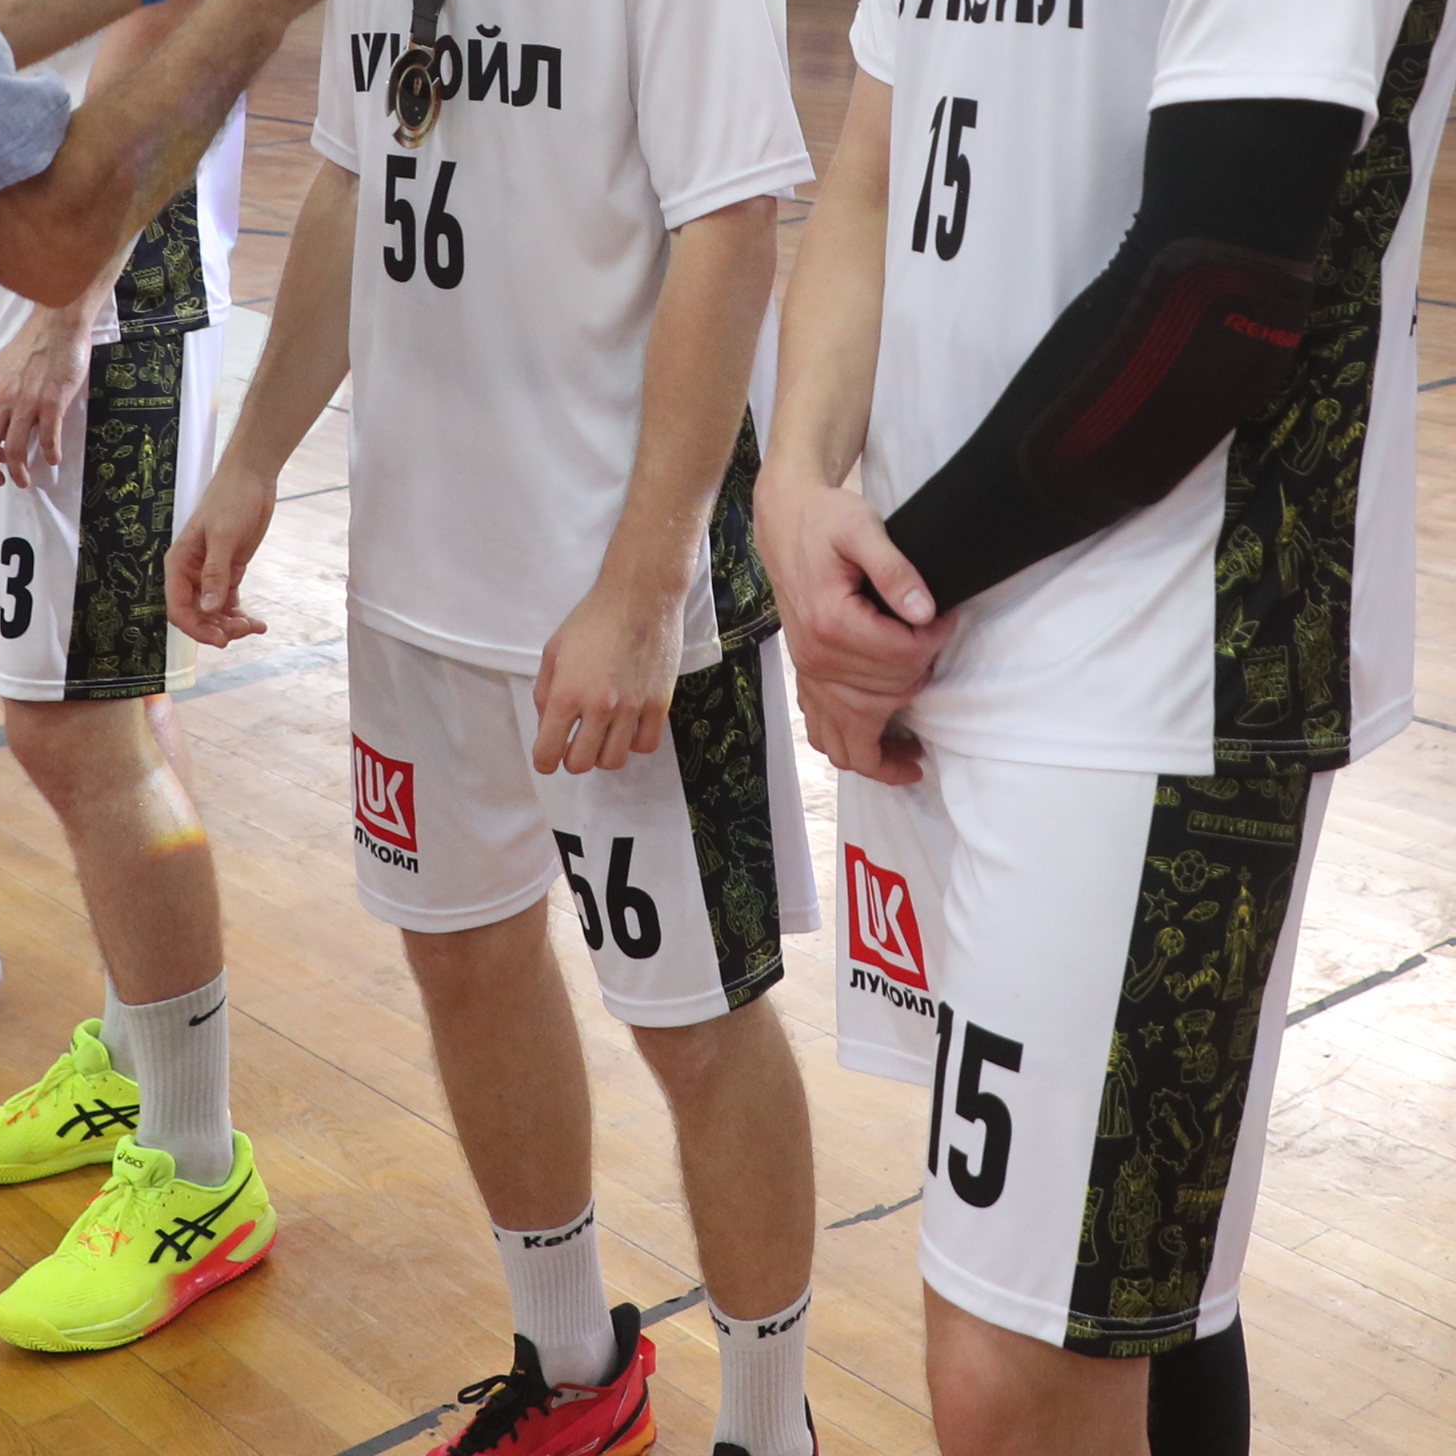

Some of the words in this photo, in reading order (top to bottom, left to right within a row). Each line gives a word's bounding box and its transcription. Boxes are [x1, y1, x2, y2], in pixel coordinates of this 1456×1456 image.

[383, 154, 465, 290] 56
[911, 96, 978, 262] 15
[354, 825, 419, 874] ЛУКОЙЛ
[552, 828, 662, 960] 56
[849, 966, 936, 1019] ЛУКОЙЛ
[928, 1000, 1024, 1209] 15
